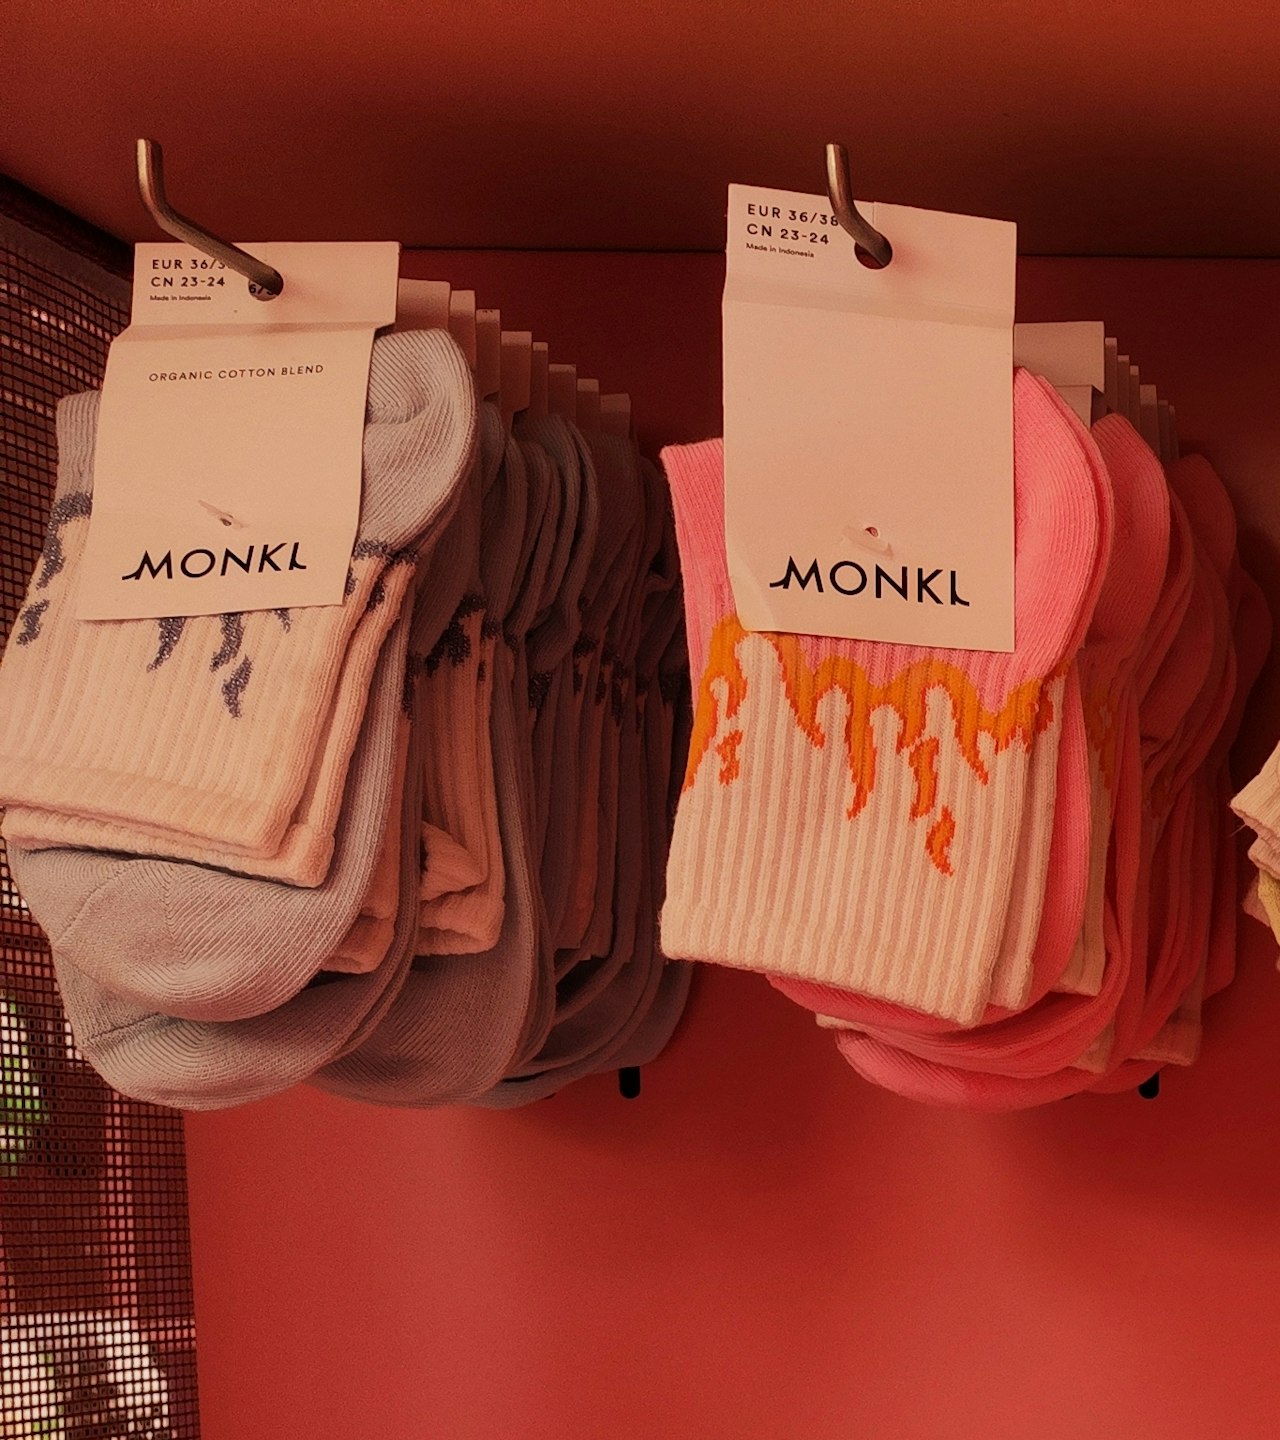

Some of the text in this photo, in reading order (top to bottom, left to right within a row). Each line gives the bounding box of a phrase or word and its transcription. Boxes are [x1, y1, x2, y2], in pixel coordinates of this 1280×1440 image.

[748, 204, 839, 227] EUR 36/38
[747, 223, 829, 245] CN 23-24
[152, 259, 183, 270] EUR
[151, 277, 225, 287] CN 23-24
[149, 365, 324, 382] ORGANIC COTTON BLEND
